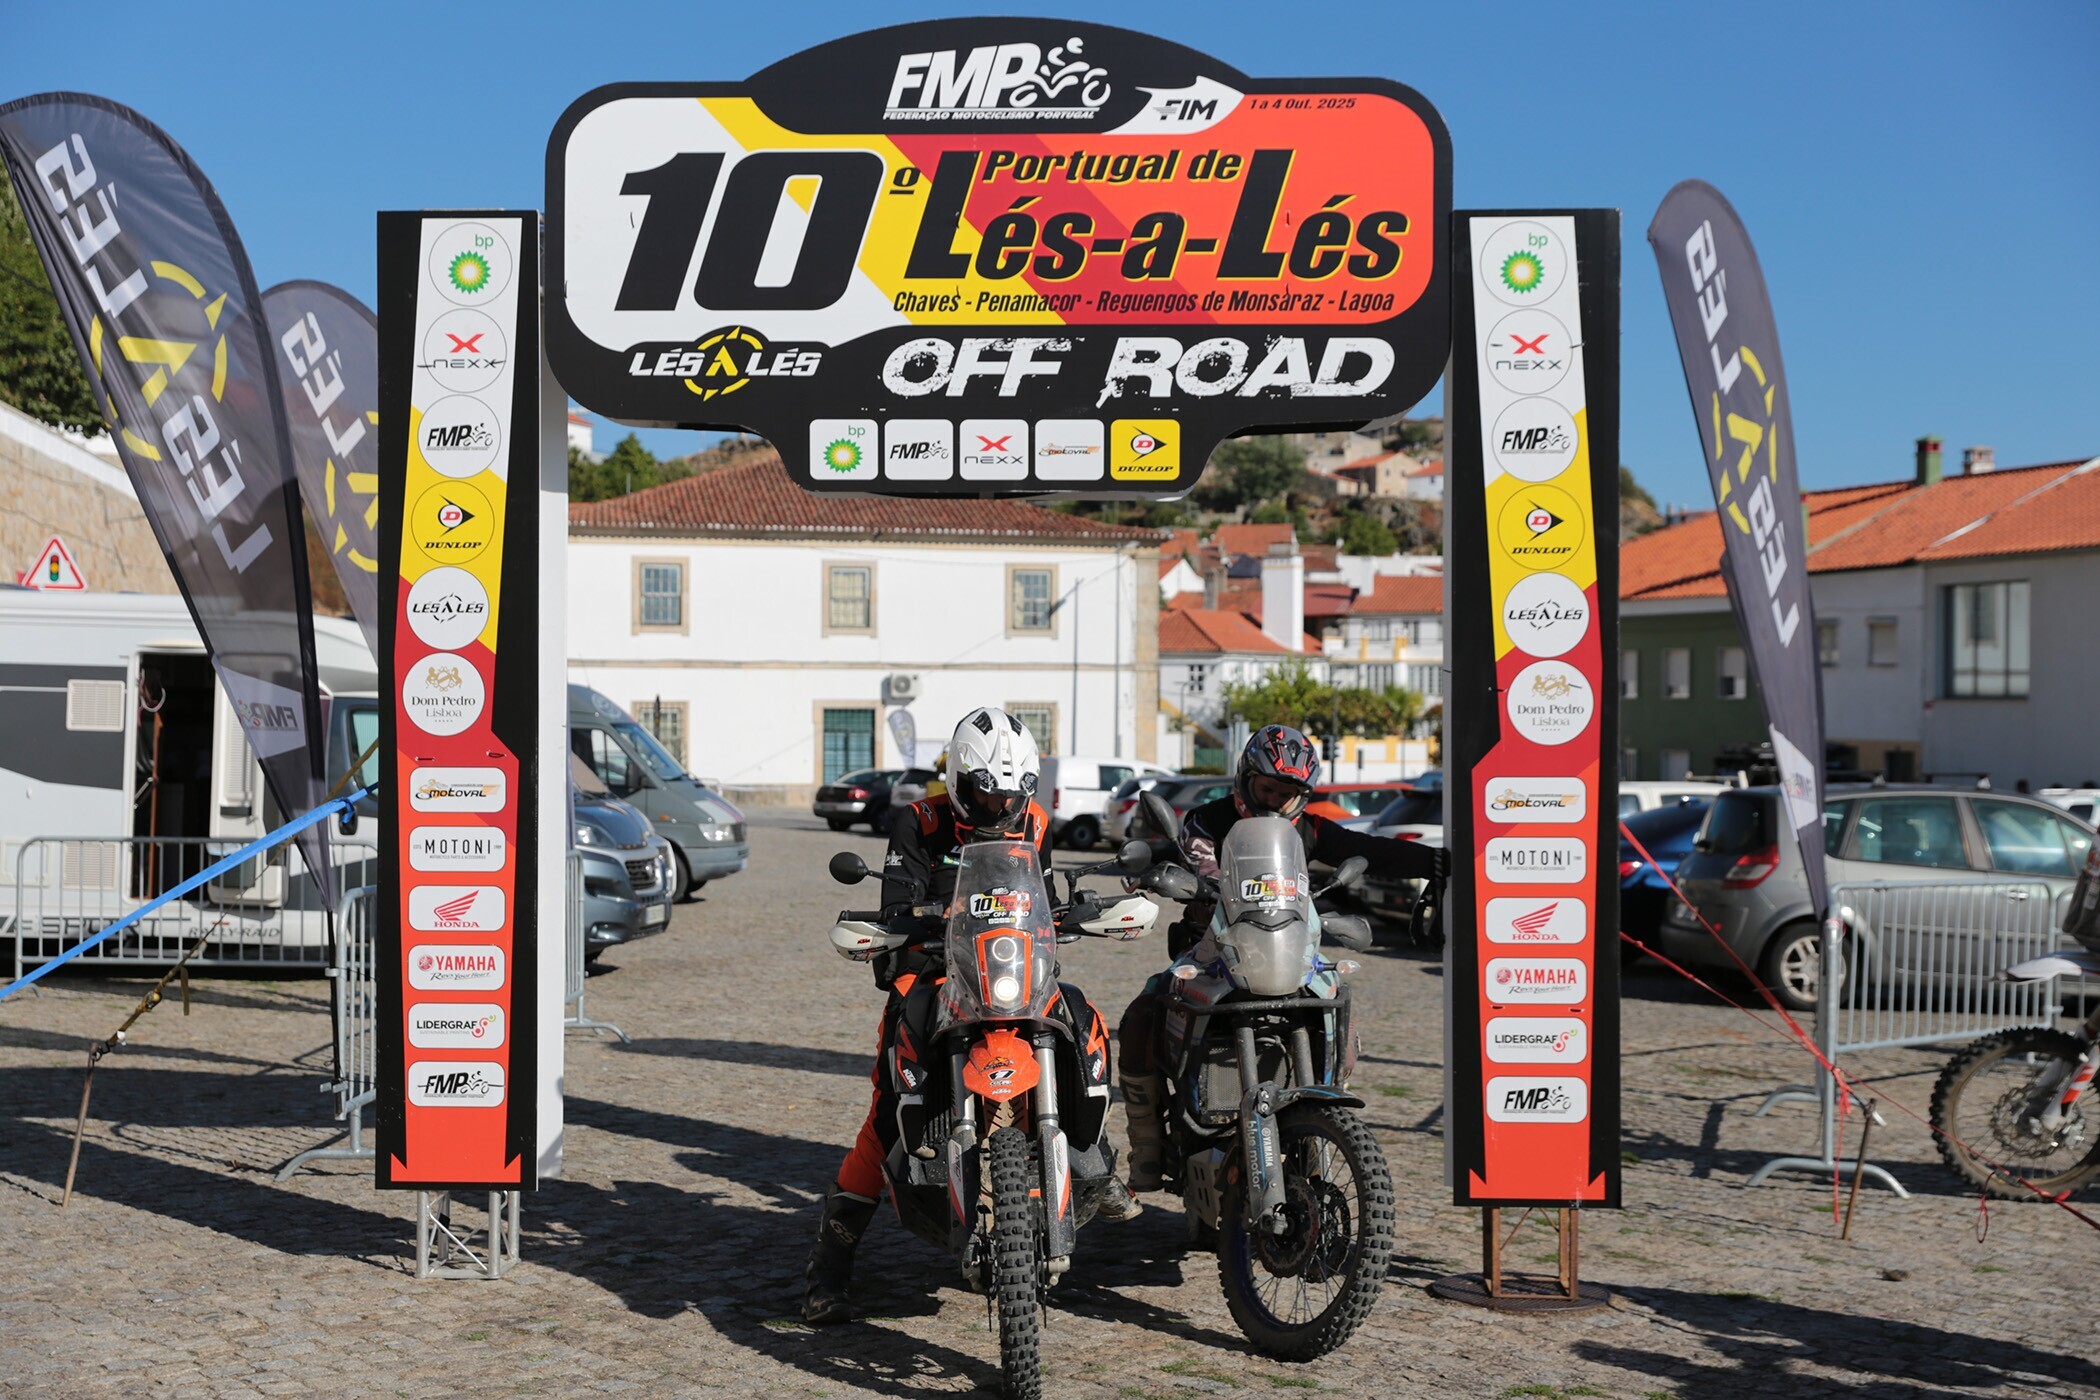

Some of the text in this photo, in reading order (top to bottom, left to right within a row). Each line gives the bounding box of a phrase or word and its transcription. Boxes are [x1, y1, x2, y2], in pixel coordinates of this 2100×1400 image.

[886, 42, 1041, 108] FMP
[1154, 99, 1218, 121] FIM
[1250, 98, 1357, 109] 1 a 4 Out. 2025
[883, 109, 1095, 121] FEDERAÇÃO MOTOCICLISMO PORTUGAL
[982, 150, 1244, 186] Portugal de
[904, 149, 1410, 282] Lés-a-Lés
[475, 234, 494, 249] bp
[1528, 233, 1548, 249] bp
[893, 290, 961, 312] Chaves
[975, 291, 1081, 312] Penamacor
[1096, 290, 1198, 314] Reguengos
[1201, 290, 1224, 312] de
[1224, 290, 1324, 312] Monsaraz
[1338, 290, 1395, 313] Lagoa
[882, 336, 1395, 406] OFF ROAD
[427, 424, 472, 447] FMP
[848, 425, 865, 438] bp
[1502, 427, 1548, 450] FMP
[890, 441, 930, 459] FMP
[424, 541, 482, 549] DUNLOP
[1512, 547, 1571, 555] DUNLOP
[412, 695, 475, 706] Dom Pedro
[426, 708, 462, 717] Lisboa
[1517, 704, 1584, 714] Dom Pedro
[1532, 717, 1570, 726] Lisboa
[425, 839, 490, 854] MOTONI
[1502, 850, 1570, 865] MOTONI
[1245, 883, 1261, 896] 10
[974, 898, 992, 912] 10
[436, 956, 496, 971] YAMAHA
[1514, 969, 1577, 984] YAMAHA
[416, 1020, 478, 1029] LIDERGRAF
[1494, 1035, 1558, 1044] LIDERGRAF
[425, 1072, 469, 1094] FMP
[1504, 1087, 1550, 1110] FMP
[1262, 1136, 1274, 1167] YAMAHA
[1249, 1150, 1262, 1190] motor
